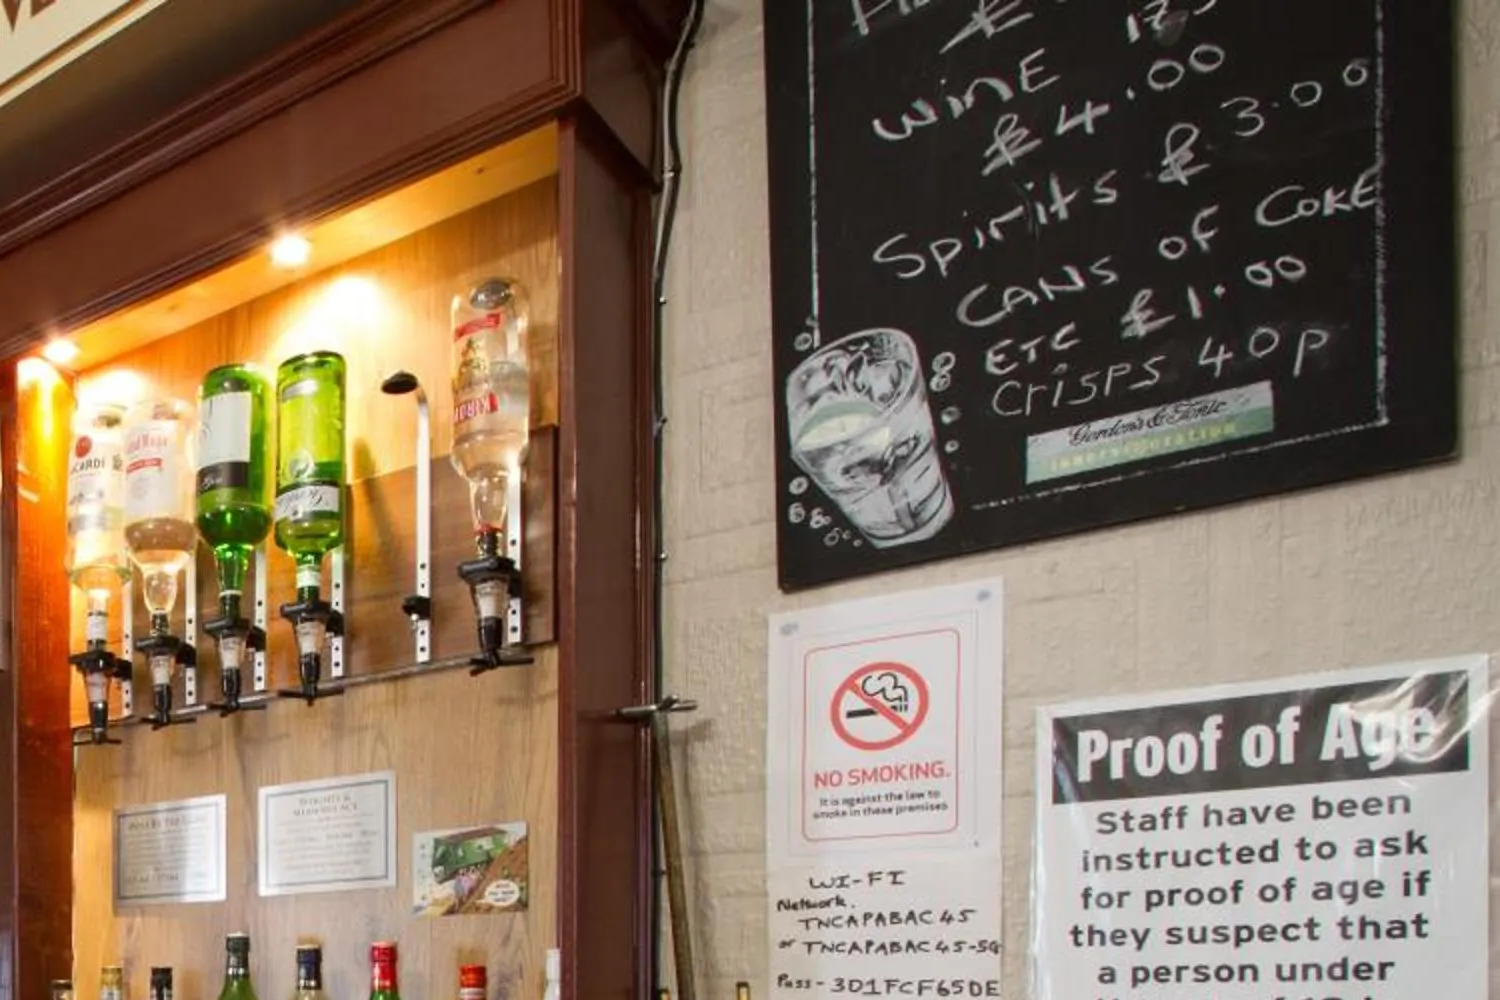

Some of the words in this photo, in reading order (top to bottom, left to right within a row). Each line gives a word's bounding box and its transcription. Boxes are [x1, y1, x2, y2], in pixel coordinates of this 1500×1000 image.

[1077, 714, 1223, 783] Proof
[1241, 706, 1300, 768] of
[1320, 703, 1436, 770] Age
[814, 770, 843, 789] NO
[841, 793, 882, 807] against
[885, 791, 903, 802] the
[905, 790, 925, 800] law
[813, 808, 847, 820] smoke
[863, 805, 893, 816] these
[896, 802, 949, 816] premises
[1097, 804, 1188, 835] Staff
[1203, 802, 1296, 829] have
[1312, 794, 1412, 820] been
[1082, 838, 1280, 872] instructed
[1295, 836, 1338, 861] to
[1354, 829, 1429, 857] ask
[1081, 887, 1130, 910] for
[1145, 879, 1244, 912] proof
[1258, 877, 1297, 902] of
[1311, 874, 1385, 905] age
[1401, 869, 1431, 897] if
[1069, 924, 1151, 951] they
[1165, 916, 1321, 948] suspect
[1337, 912, 1430, 940] that
[1098, 964, 1117, 984] a
[1131, 959, 1259, 988] person
[1275, 957, 1395, 982] under
